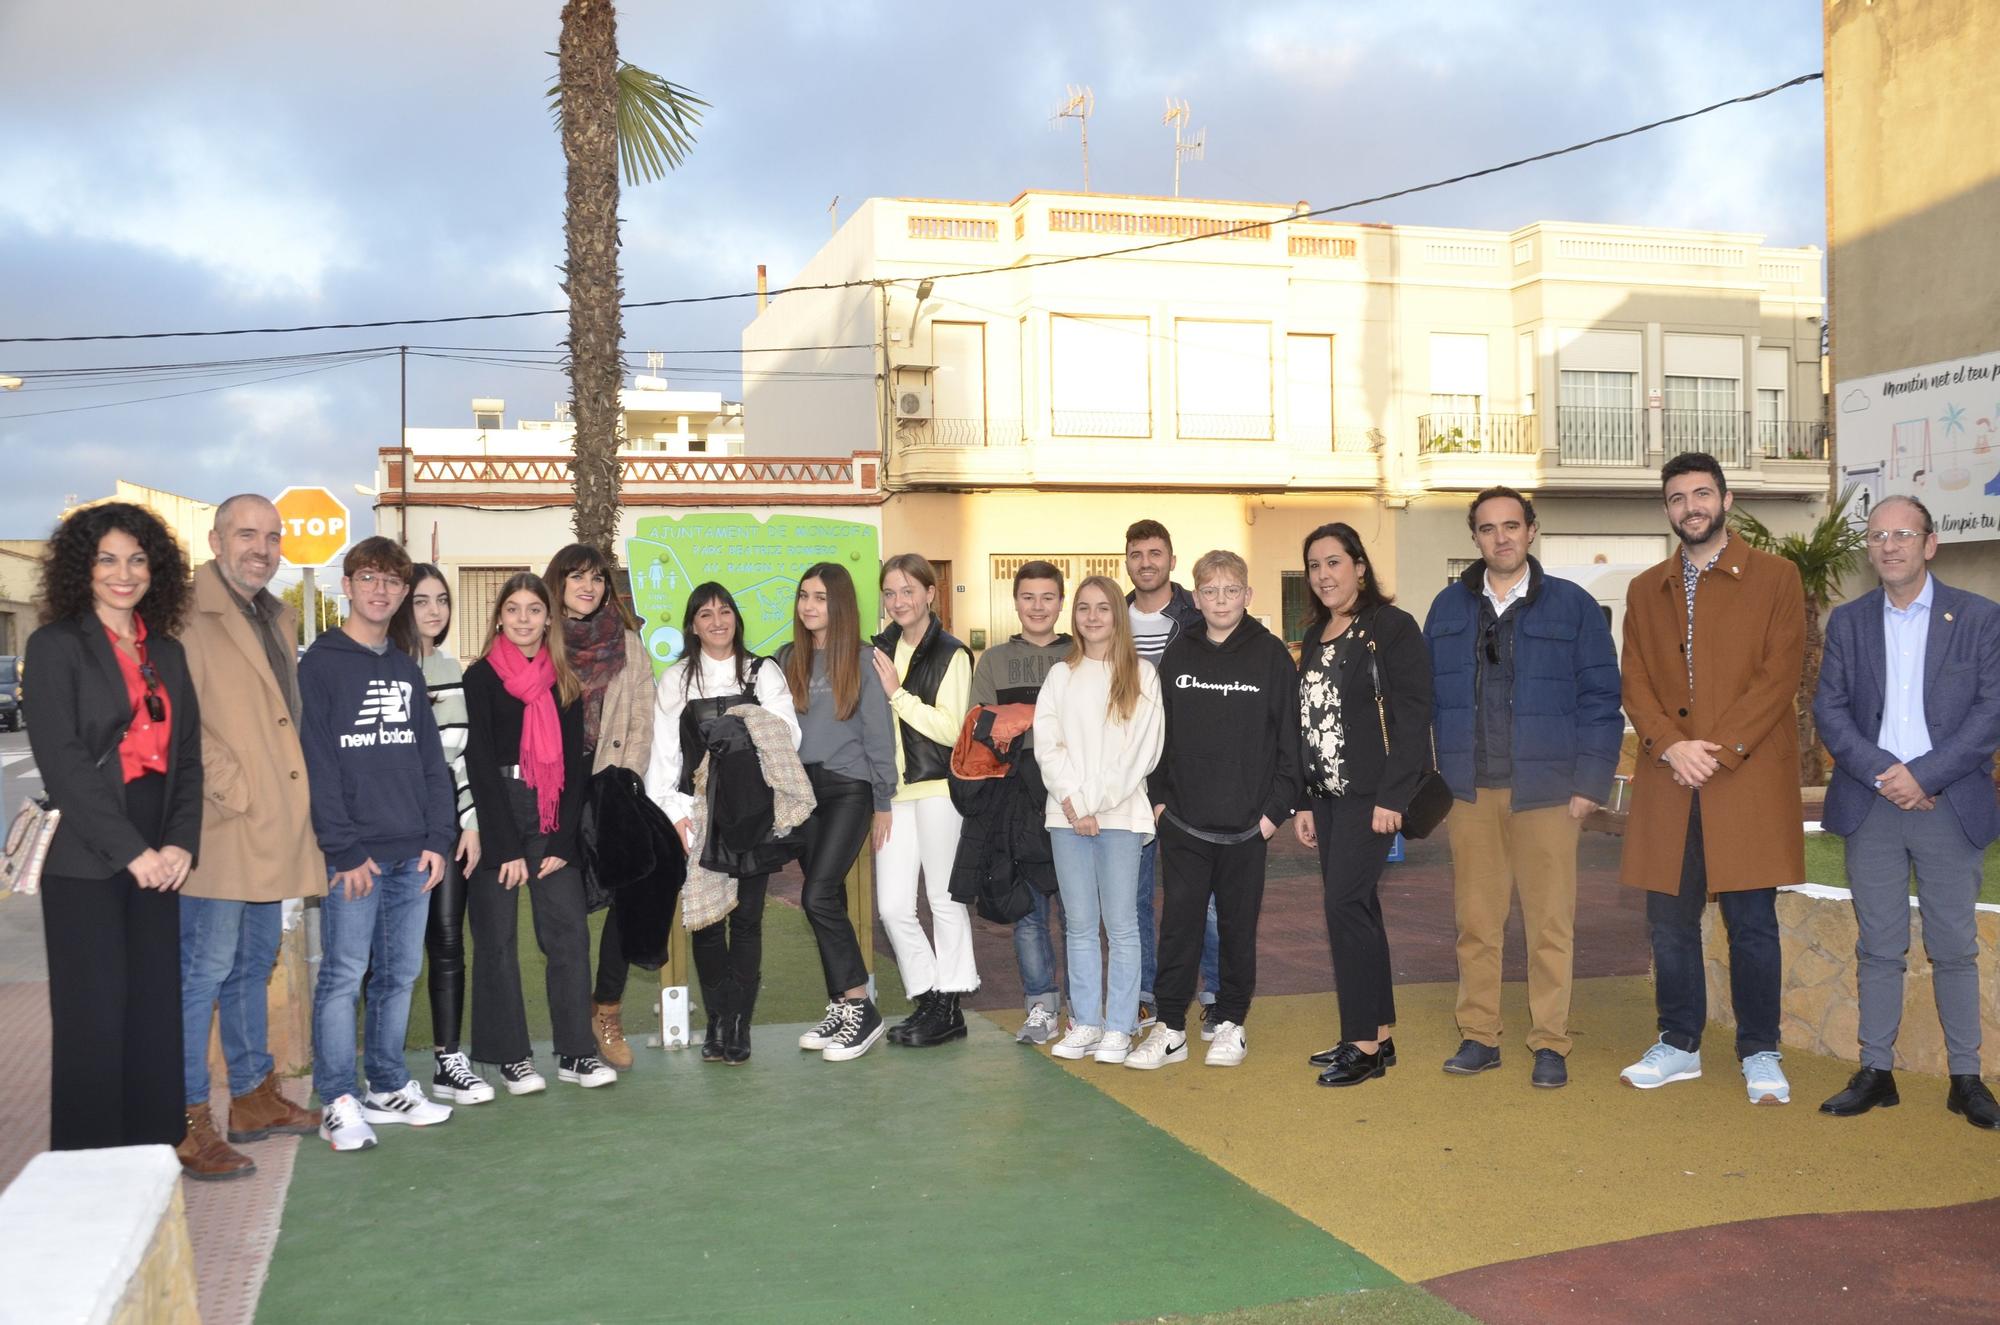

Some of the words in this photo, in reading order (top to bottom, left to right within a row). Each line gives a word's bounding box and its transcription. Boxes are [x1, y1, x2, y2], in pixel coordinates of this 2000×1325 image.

[1931, 371, 1951, 388] net
[1953, 365, 1966, 383] el
[1967, 366, 1989, 381] teu
[1981, 514, 1995, 528] tu
[650, 525, 761, 538] AJUNTAMENT
[768, 525, 787, 537] DE
[795, 525, 872, 537] MONCOFA
[1176, 674, 1260, 697] Champion
[340, 732, 377, 748] new
